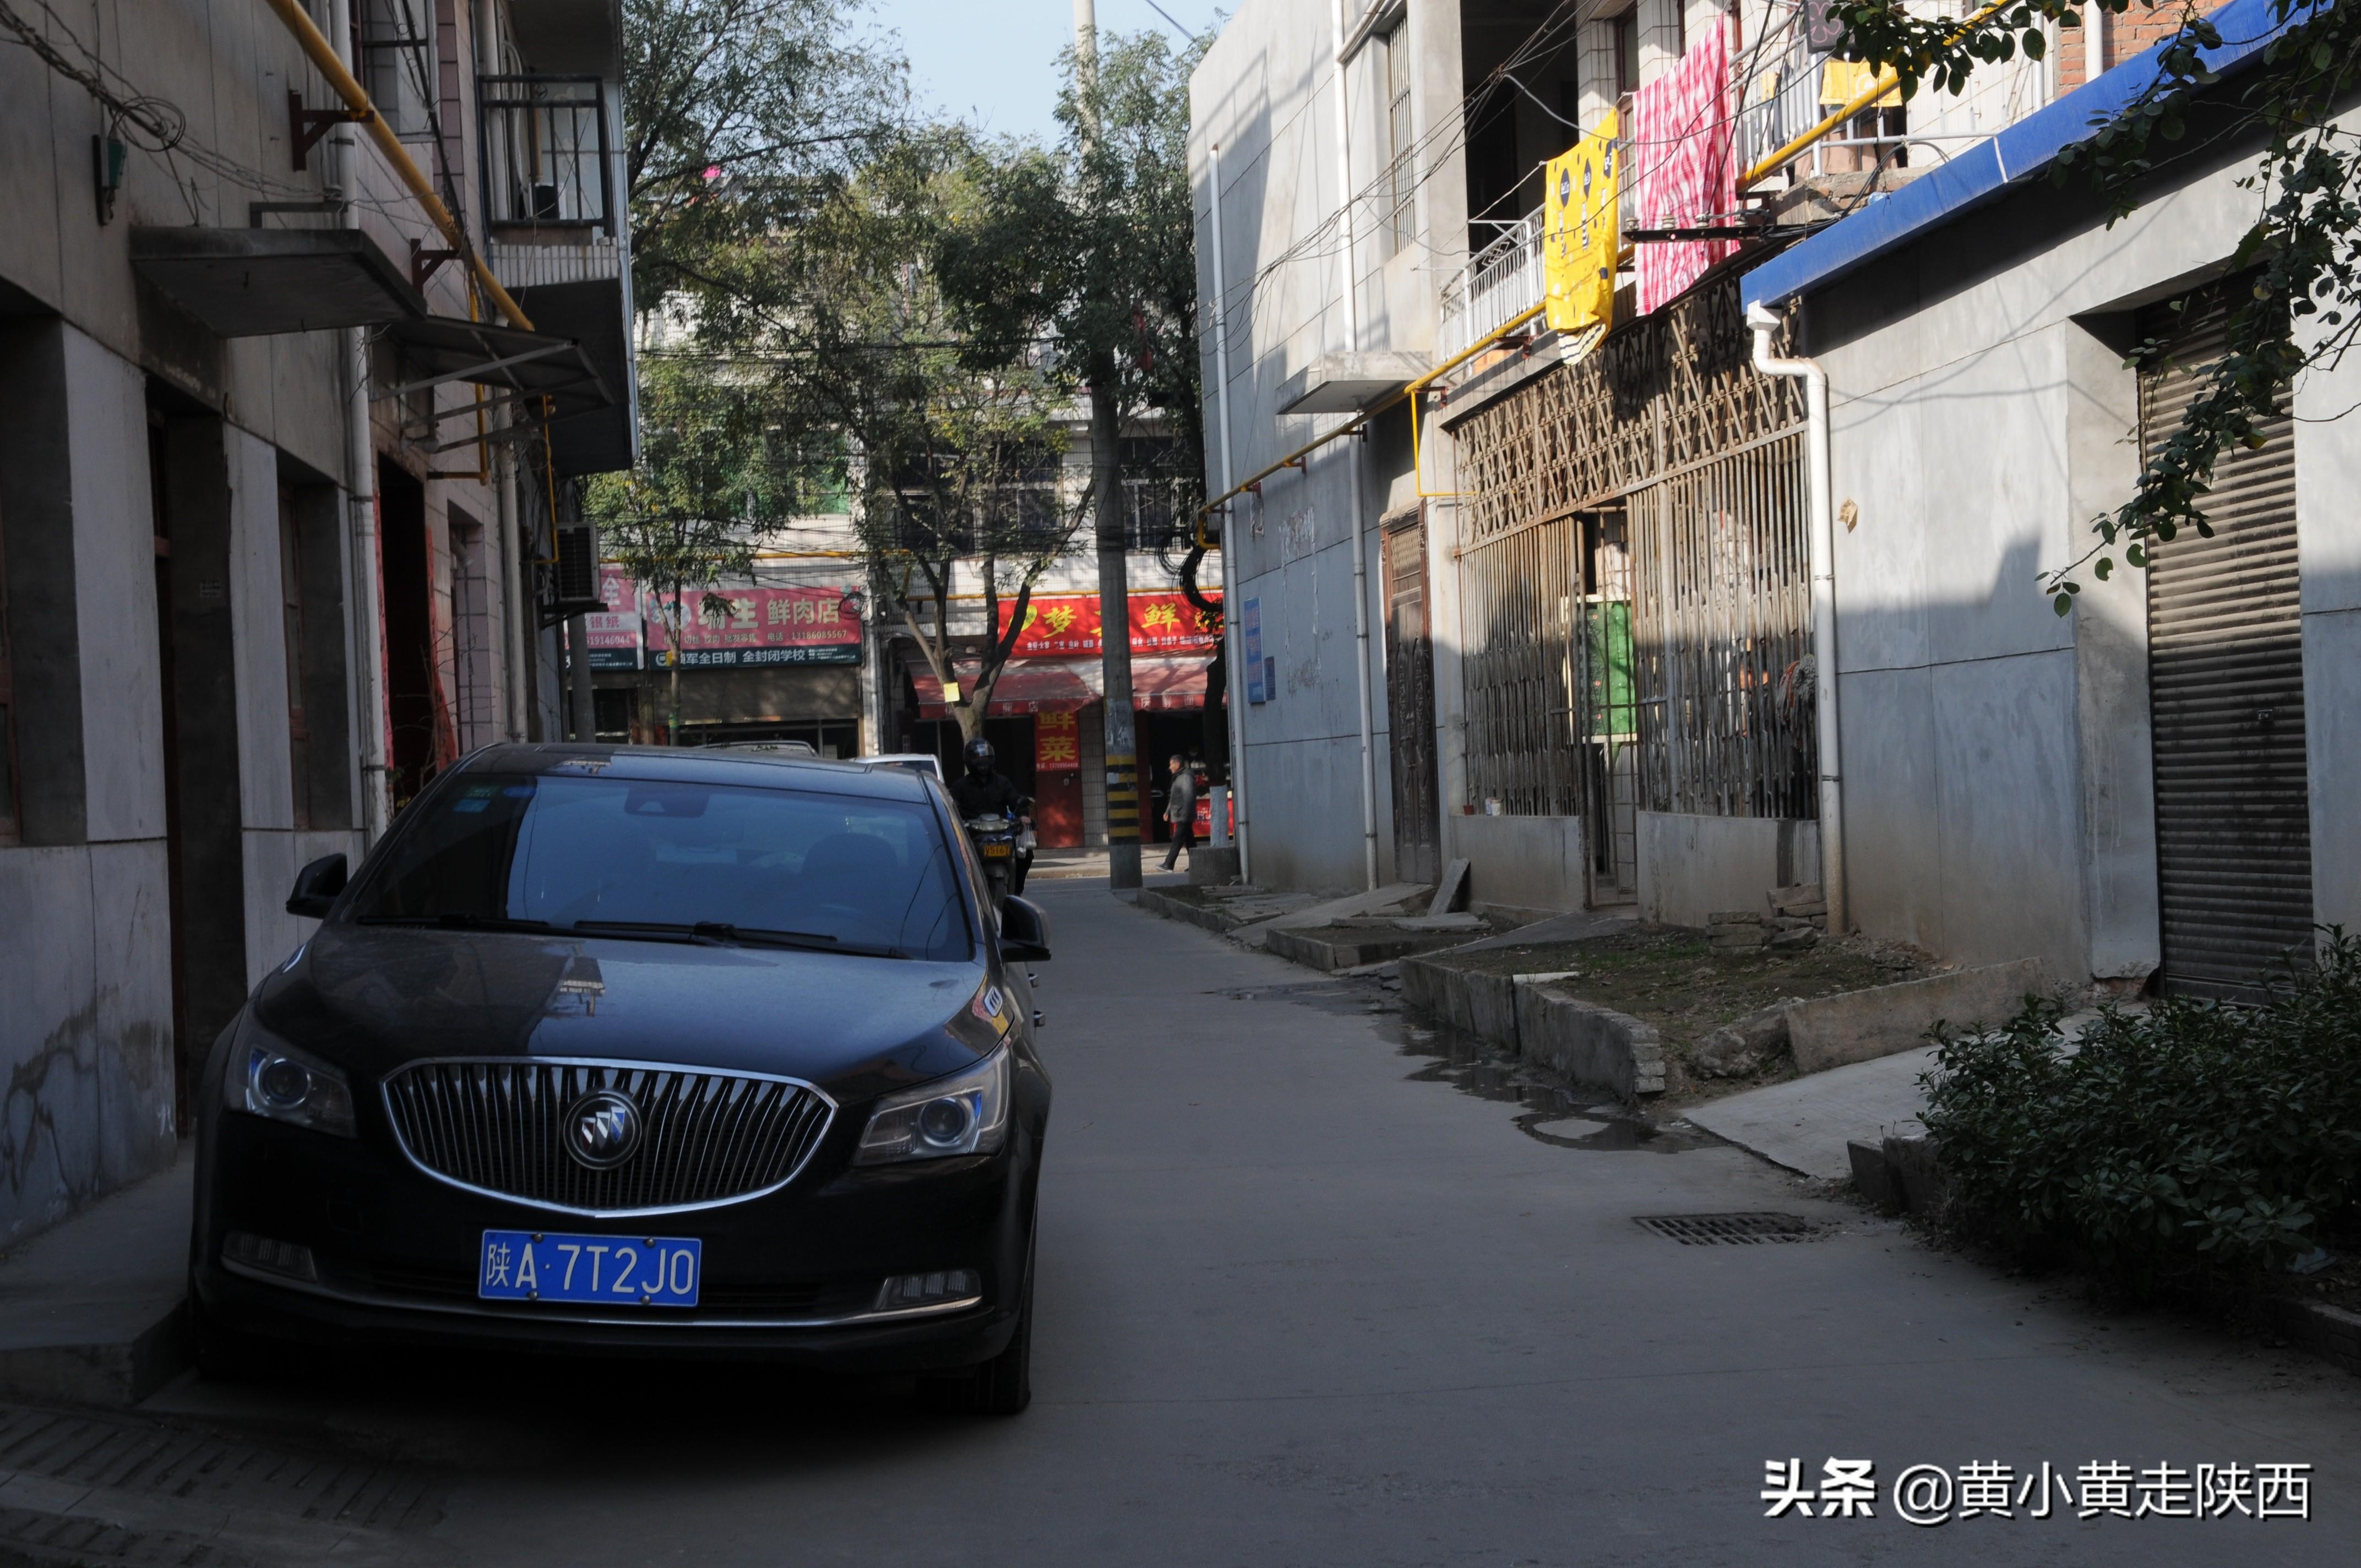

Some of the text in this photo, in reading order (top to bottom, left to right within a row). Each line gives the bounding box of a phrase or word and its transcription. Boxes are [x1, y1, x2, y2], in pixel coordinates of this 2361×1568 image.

[602, 574, 620, 605] 全
[767, 598, 840, 625] 鲜肉店
[725, 633, 757, 644] 批发零售
[743, 648, 806, 662] 全封闭学校
